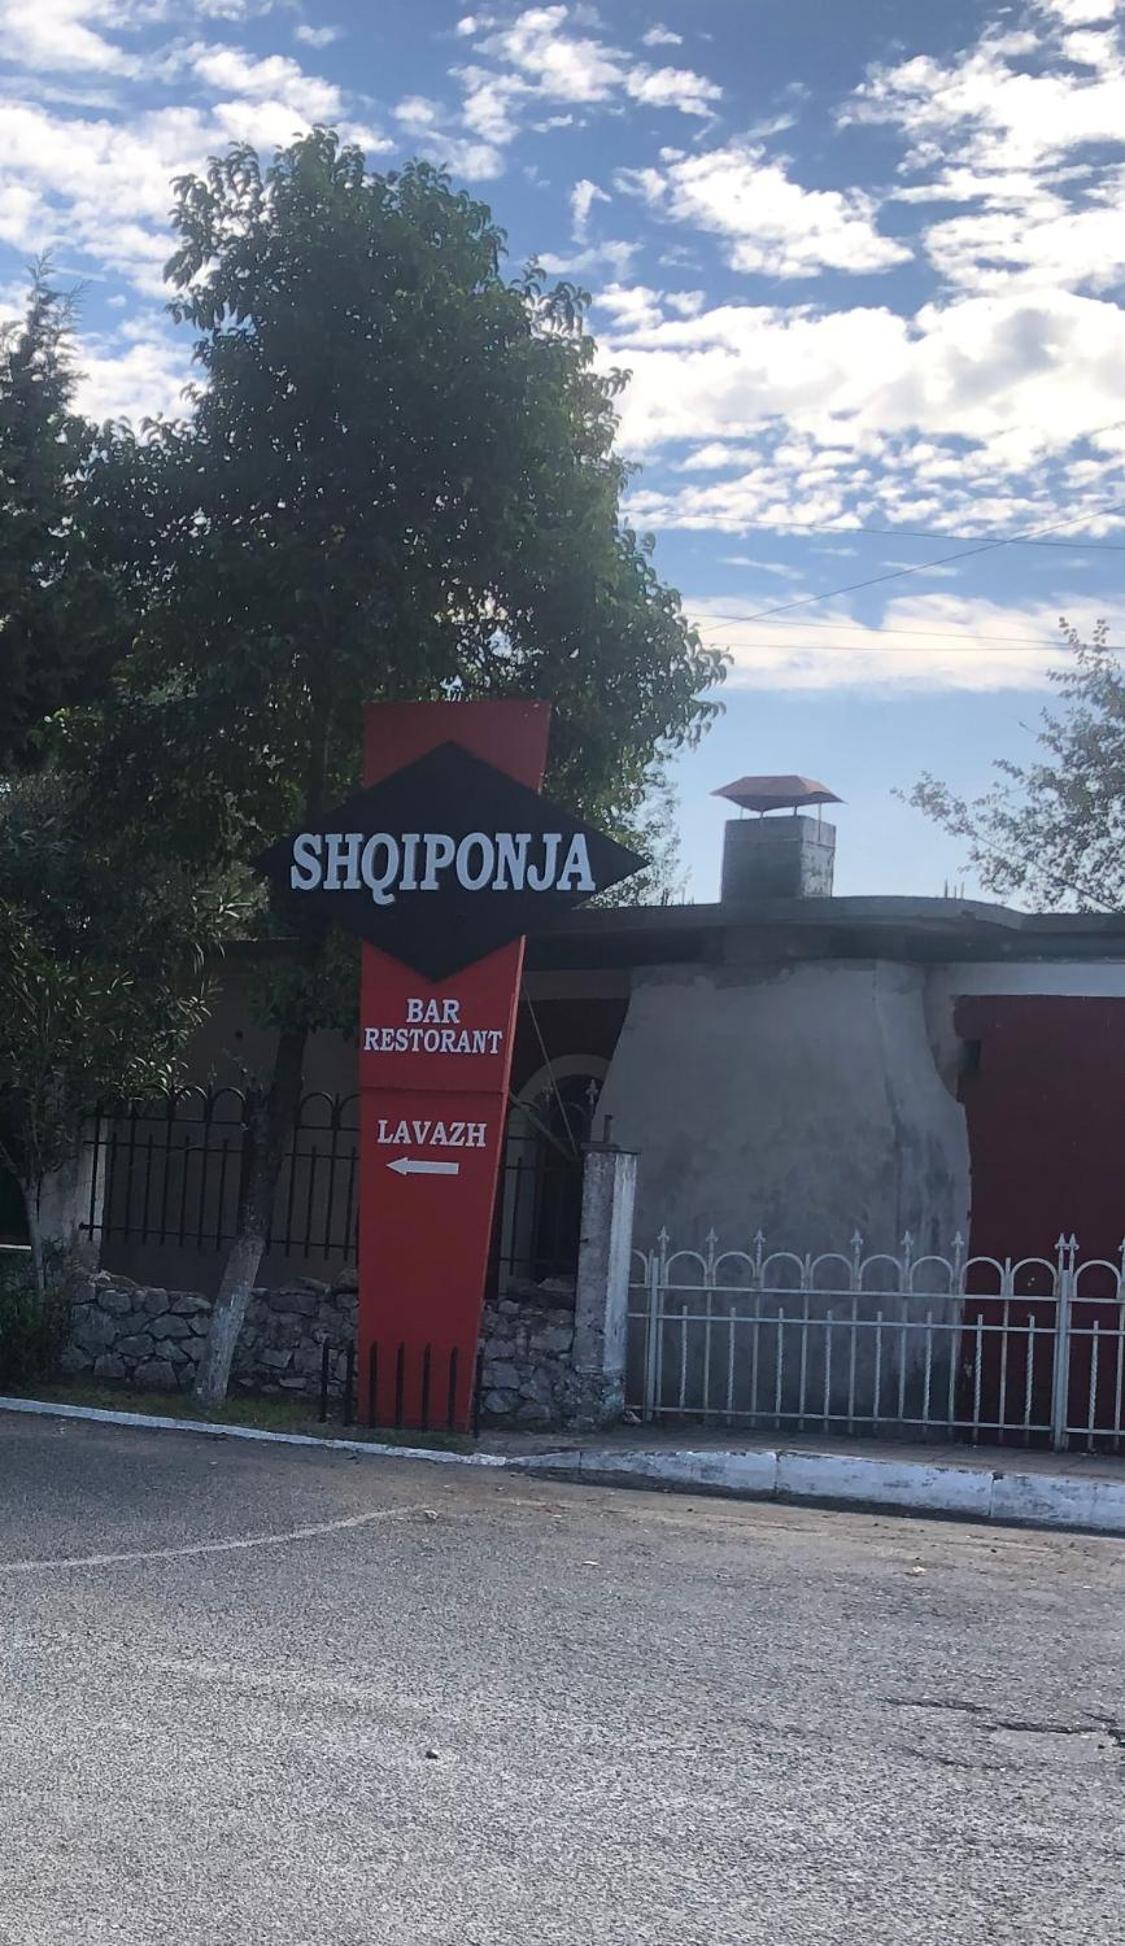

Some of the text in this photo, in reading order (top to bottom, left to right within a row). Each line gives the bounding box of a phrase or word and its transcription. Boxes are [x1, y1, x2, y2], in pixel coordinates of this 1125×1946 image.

[290, 832, 596, 905] SHQIPONJA
[406, 998, 460, 1024] BAR
[363, 1028, 503, 1055] RESTORANT
[377, 1119, 487, 1148] LAVAZH
